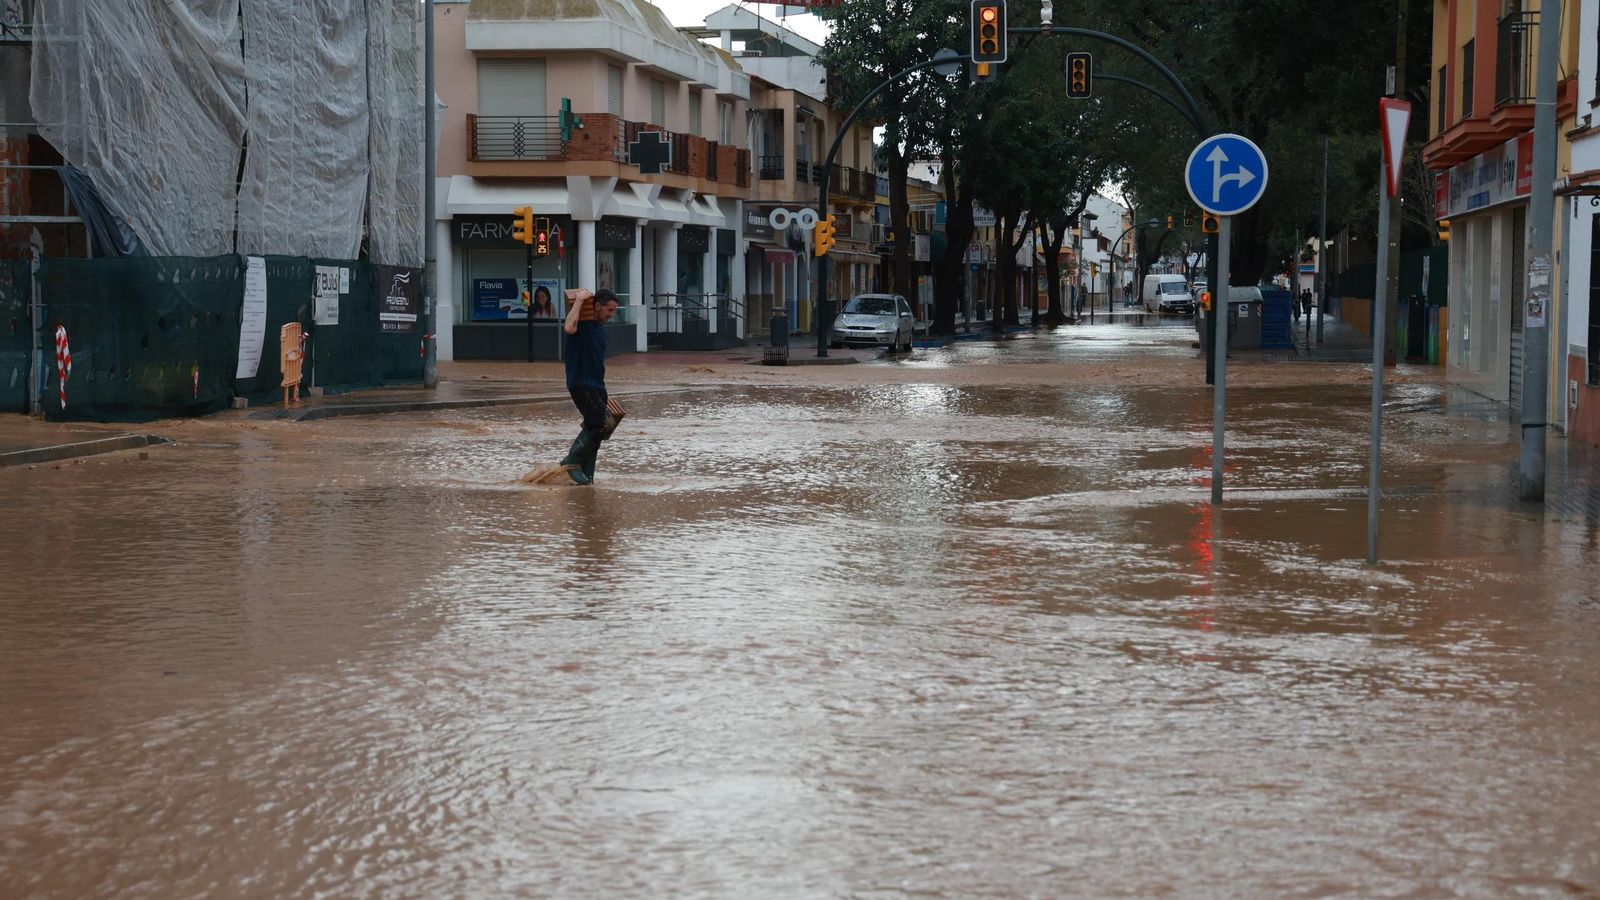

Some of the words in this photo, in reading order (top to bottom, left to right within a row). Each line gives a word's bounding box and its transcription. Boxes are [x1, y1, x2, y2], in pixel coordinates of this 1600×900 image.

[461, 224, 560, 238] FARMA
[538, 244, 547, 254] 25
[479, 281, 503, 289] Flavia
